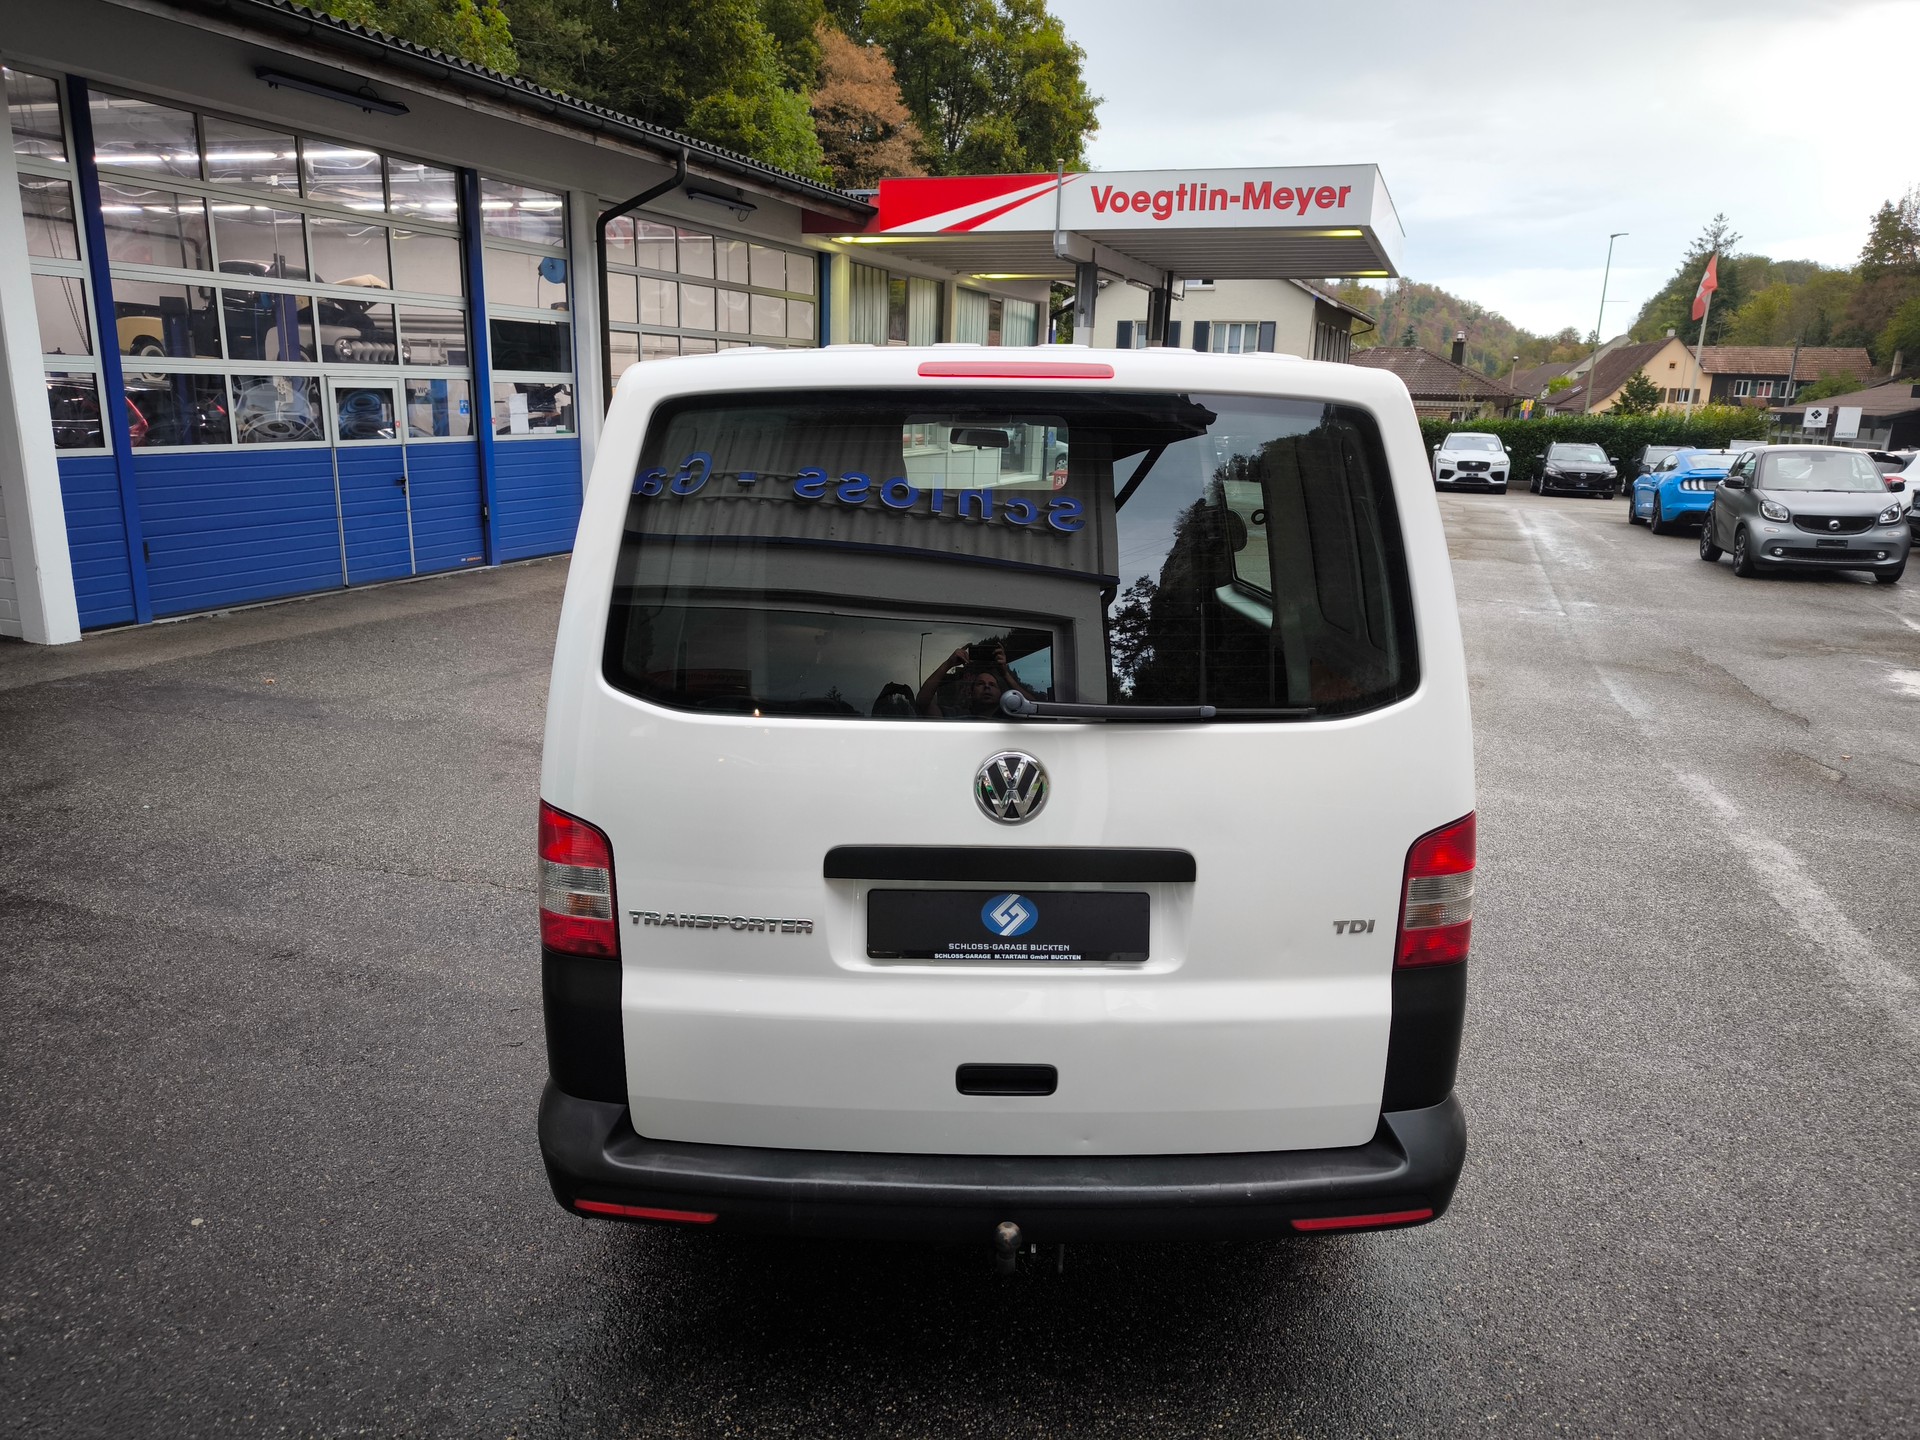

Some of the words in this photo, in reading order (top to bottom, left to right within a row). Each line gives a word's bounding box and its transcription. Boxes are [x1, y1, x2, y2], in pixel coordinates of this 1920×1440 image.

[1090, 181, 1352, 221] Voegtlin-Meyer
[628, 909, 814, 934] TRANSPORTER
[1333, 919, 1376, 934] TDI
[948, 943, 1028, 951] SCHLOSS-GARAGE
